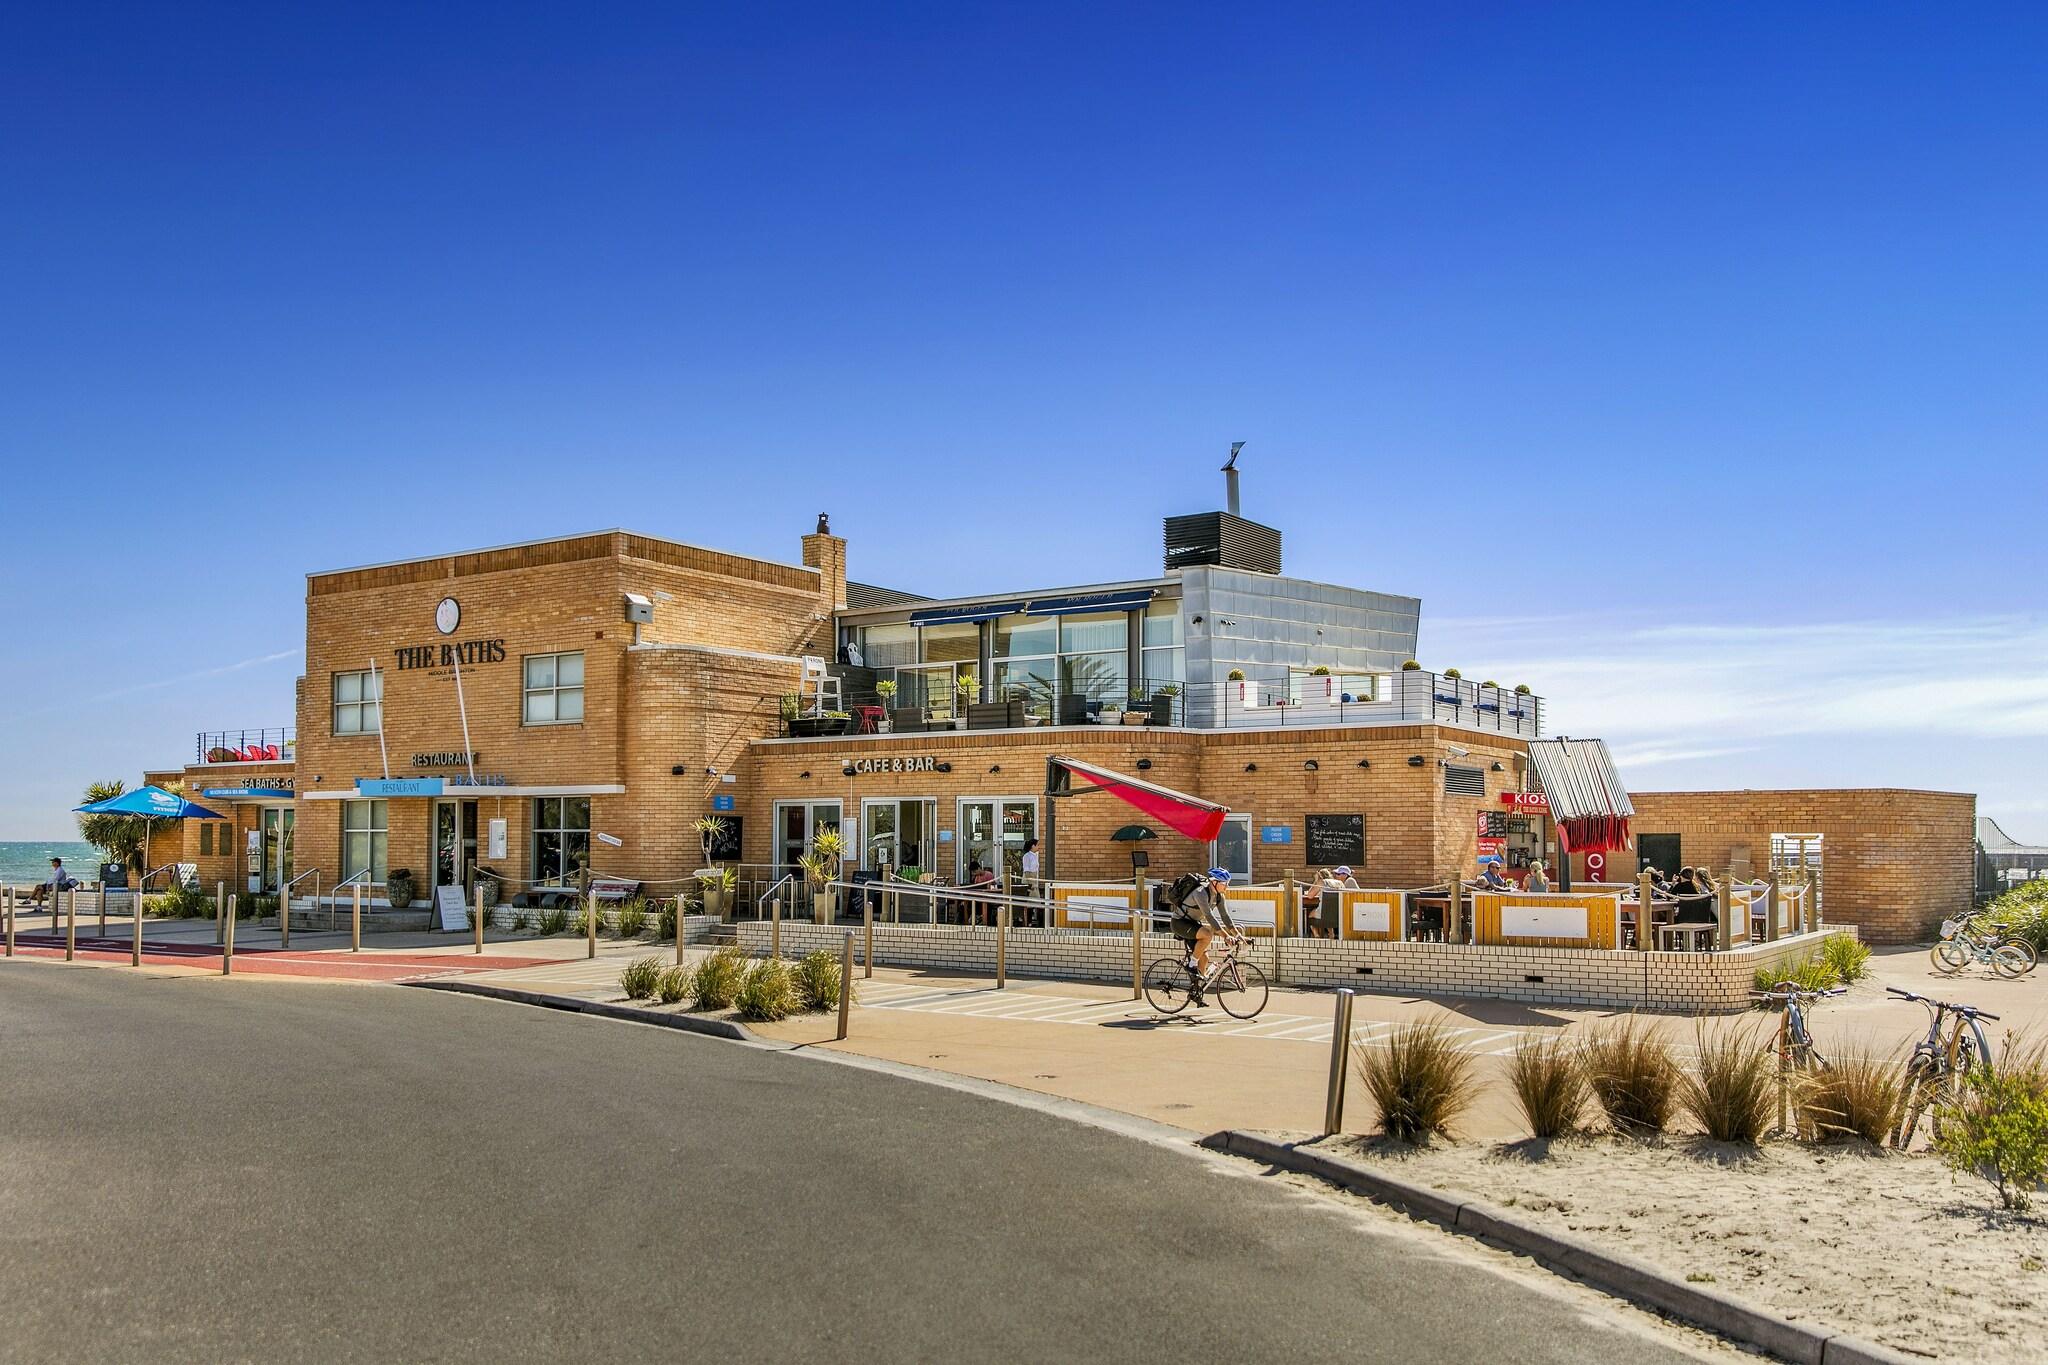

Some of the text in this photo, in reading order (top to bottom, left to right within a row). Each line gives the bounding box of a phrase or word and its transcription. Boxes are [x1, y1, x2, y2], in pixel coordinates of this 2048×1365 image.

[395, 639, 505, 669] THE BATHS
[449, 667, 476, 675] BRHTON
[411, 752, 476, 766] RESTAURANT
[855, 756, 934, 773] CAFE & BAR
[241, 778, 255, 789] SEA
[256, 778, 280, 789] BATHS
[455, 774, 506, 786] BATHS
[382, 783, 420, 793] RESTAURANT
[1515, 793, 1547, 804] KIOS
